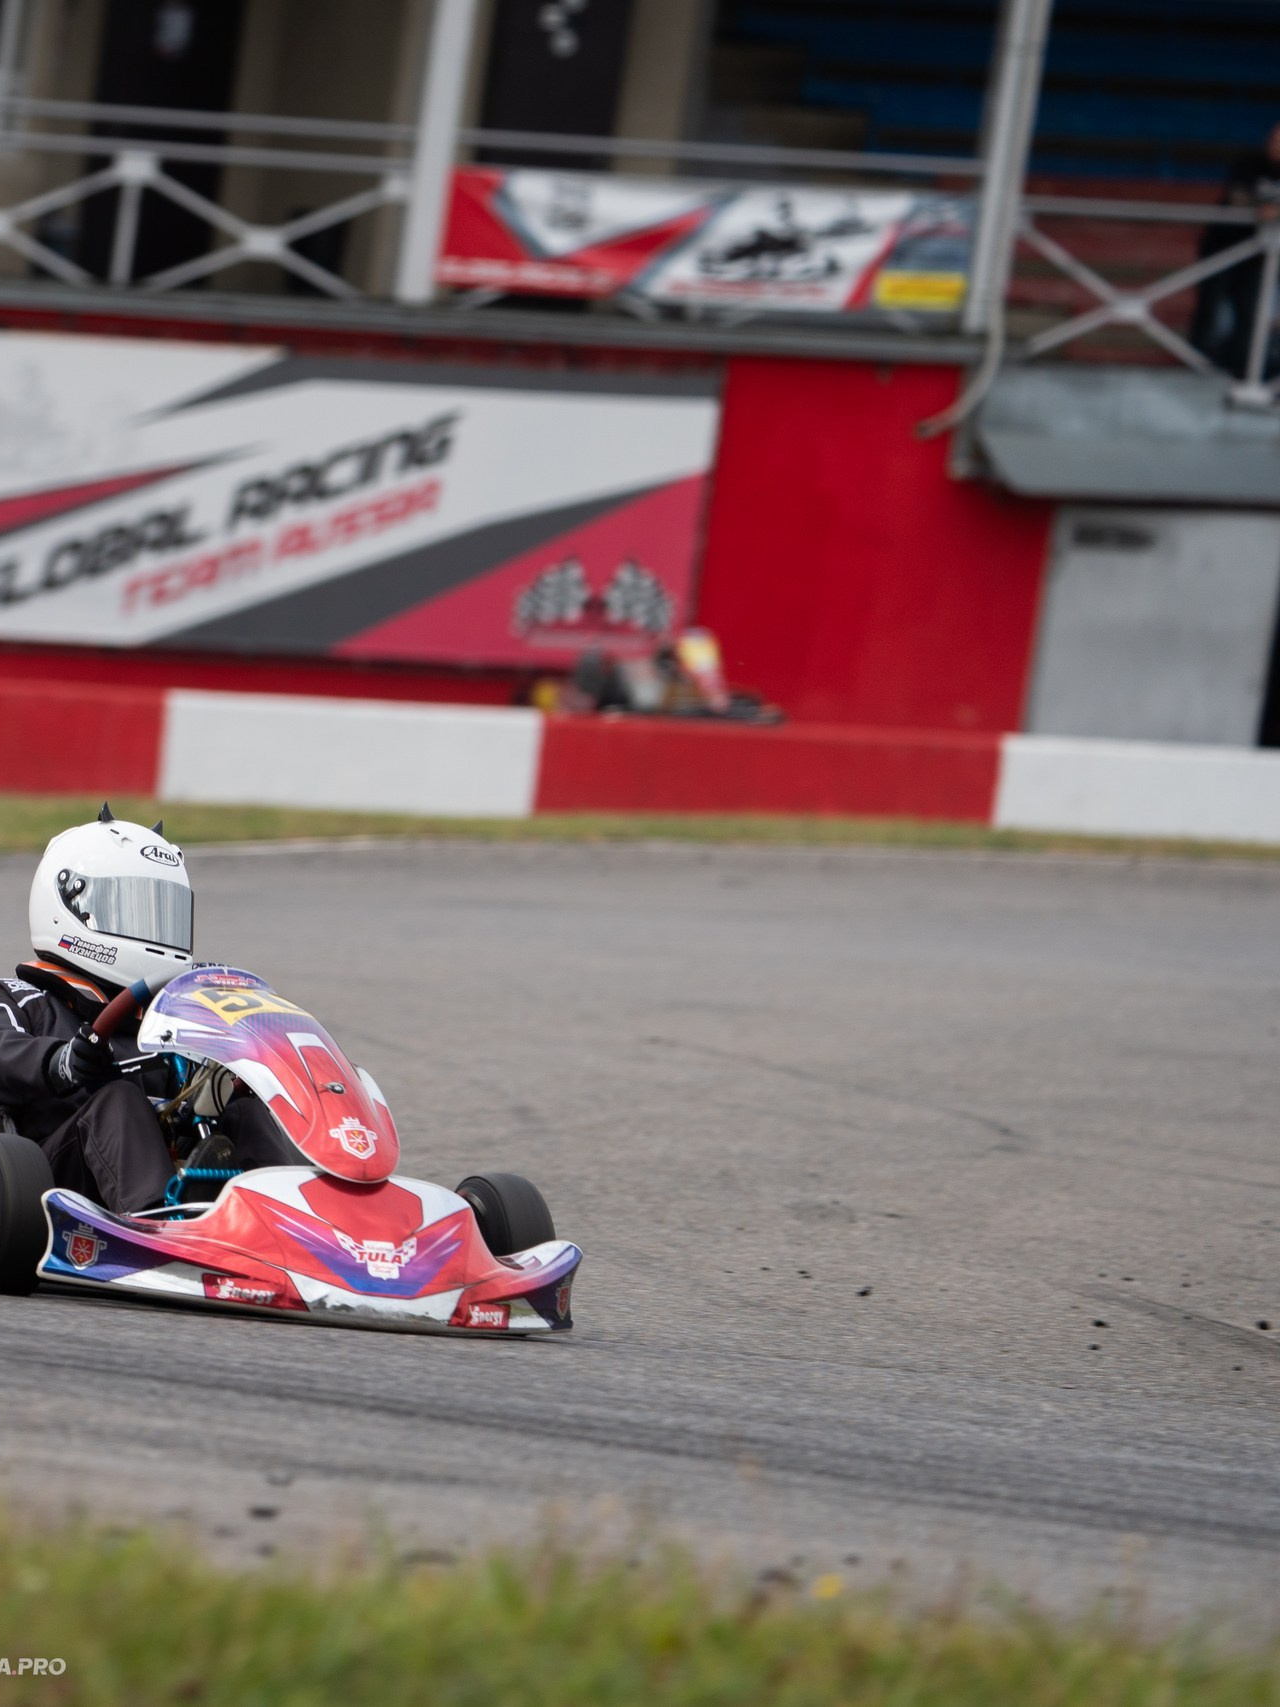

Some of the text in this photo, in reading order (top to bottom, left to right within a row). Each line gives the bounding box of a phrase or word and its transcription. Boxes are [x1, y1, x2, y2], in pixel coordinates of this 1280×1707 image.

[224, 405, 466, 530] RACING
[122, 537, 264, 616] TEAM
[144, 847, 176, 863] Arai
[68, 944, 117, 965] КУЗНЕЦОВ
[73, 936, 118, 957] Тимофей
[358, 1251, 403, 1265] TULA
